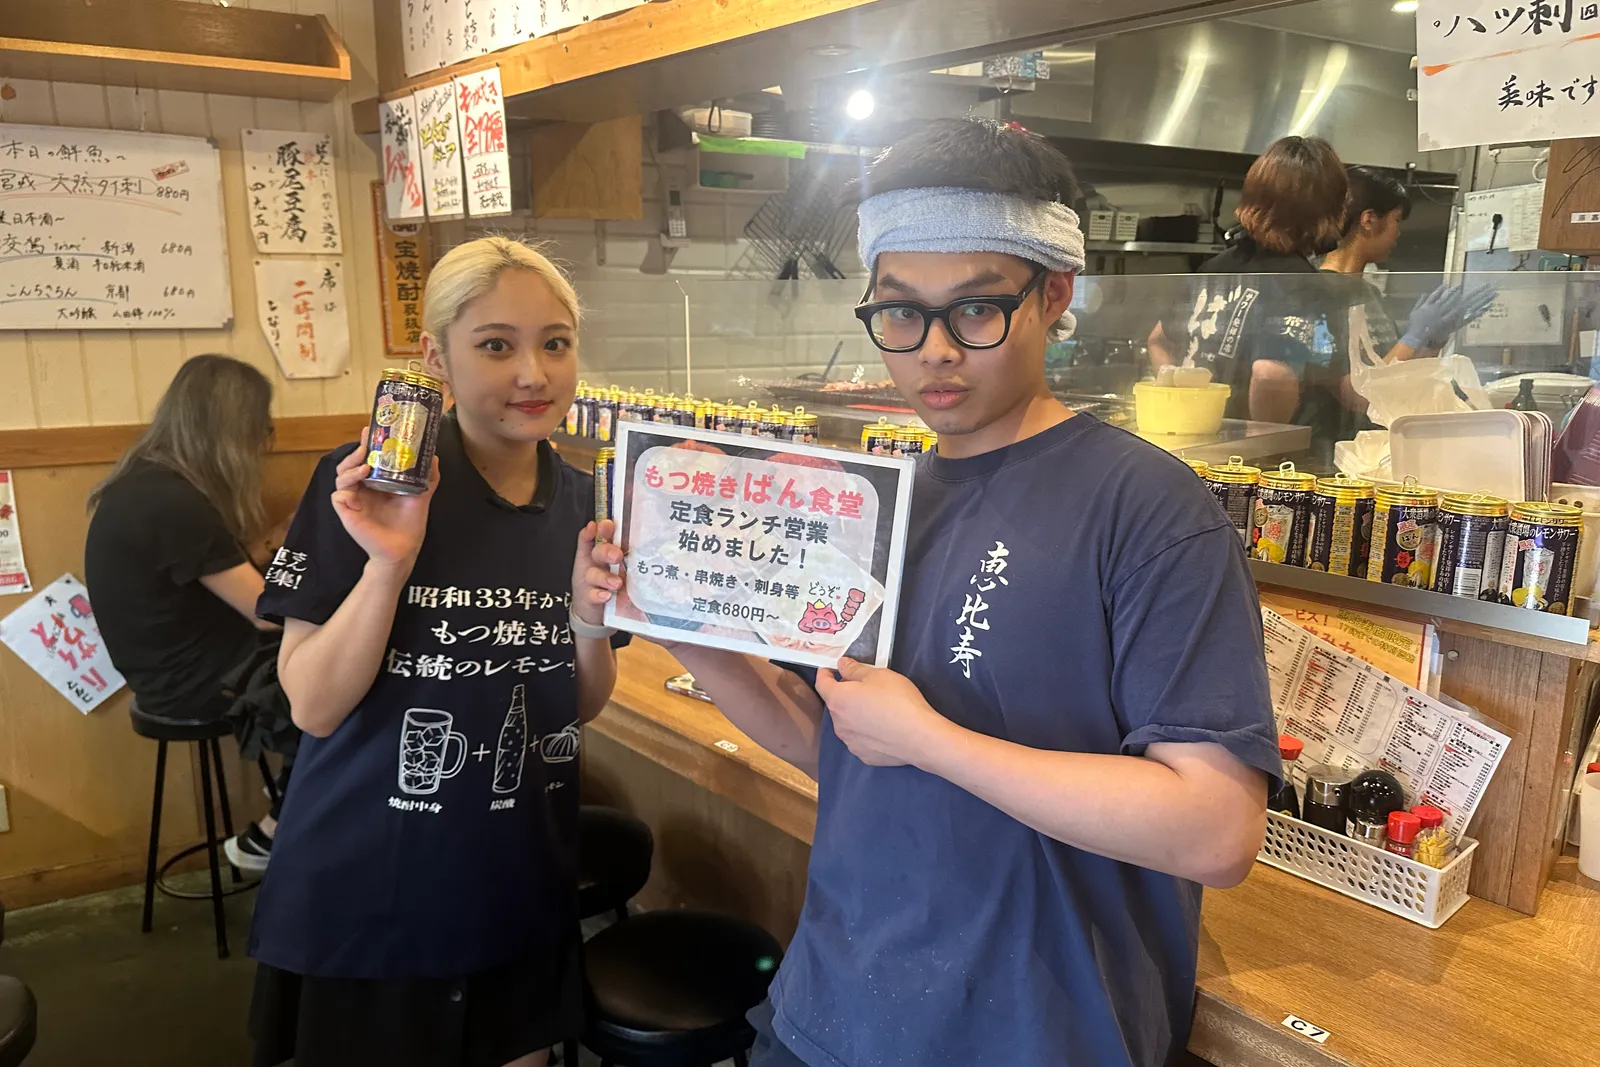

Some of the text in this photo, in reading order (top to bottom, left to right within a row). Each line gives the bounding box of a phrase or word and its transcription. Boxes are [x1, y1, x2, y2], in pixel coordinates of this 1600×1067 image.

[156, 186, 190, 202] 880円
[161, 242, 193, 257] 680円
[163, 285, 196, 299] 680円
[644, 466, 865, 520] もつ焼きばん食堂
[669, 500, 829, 544] 定食ランチ営業
[677, 528, 806, 570] 始めました!
[636, 560, 800, 600] もつ煮・串焼き・刺身等
[808, 580, 840, 597] どうぞ
[949, 540, 1010, 679] 恵比寿
[388, 795, 443, 813] 焼酎中身
[1290, 1019, 1325, 1037] C7
